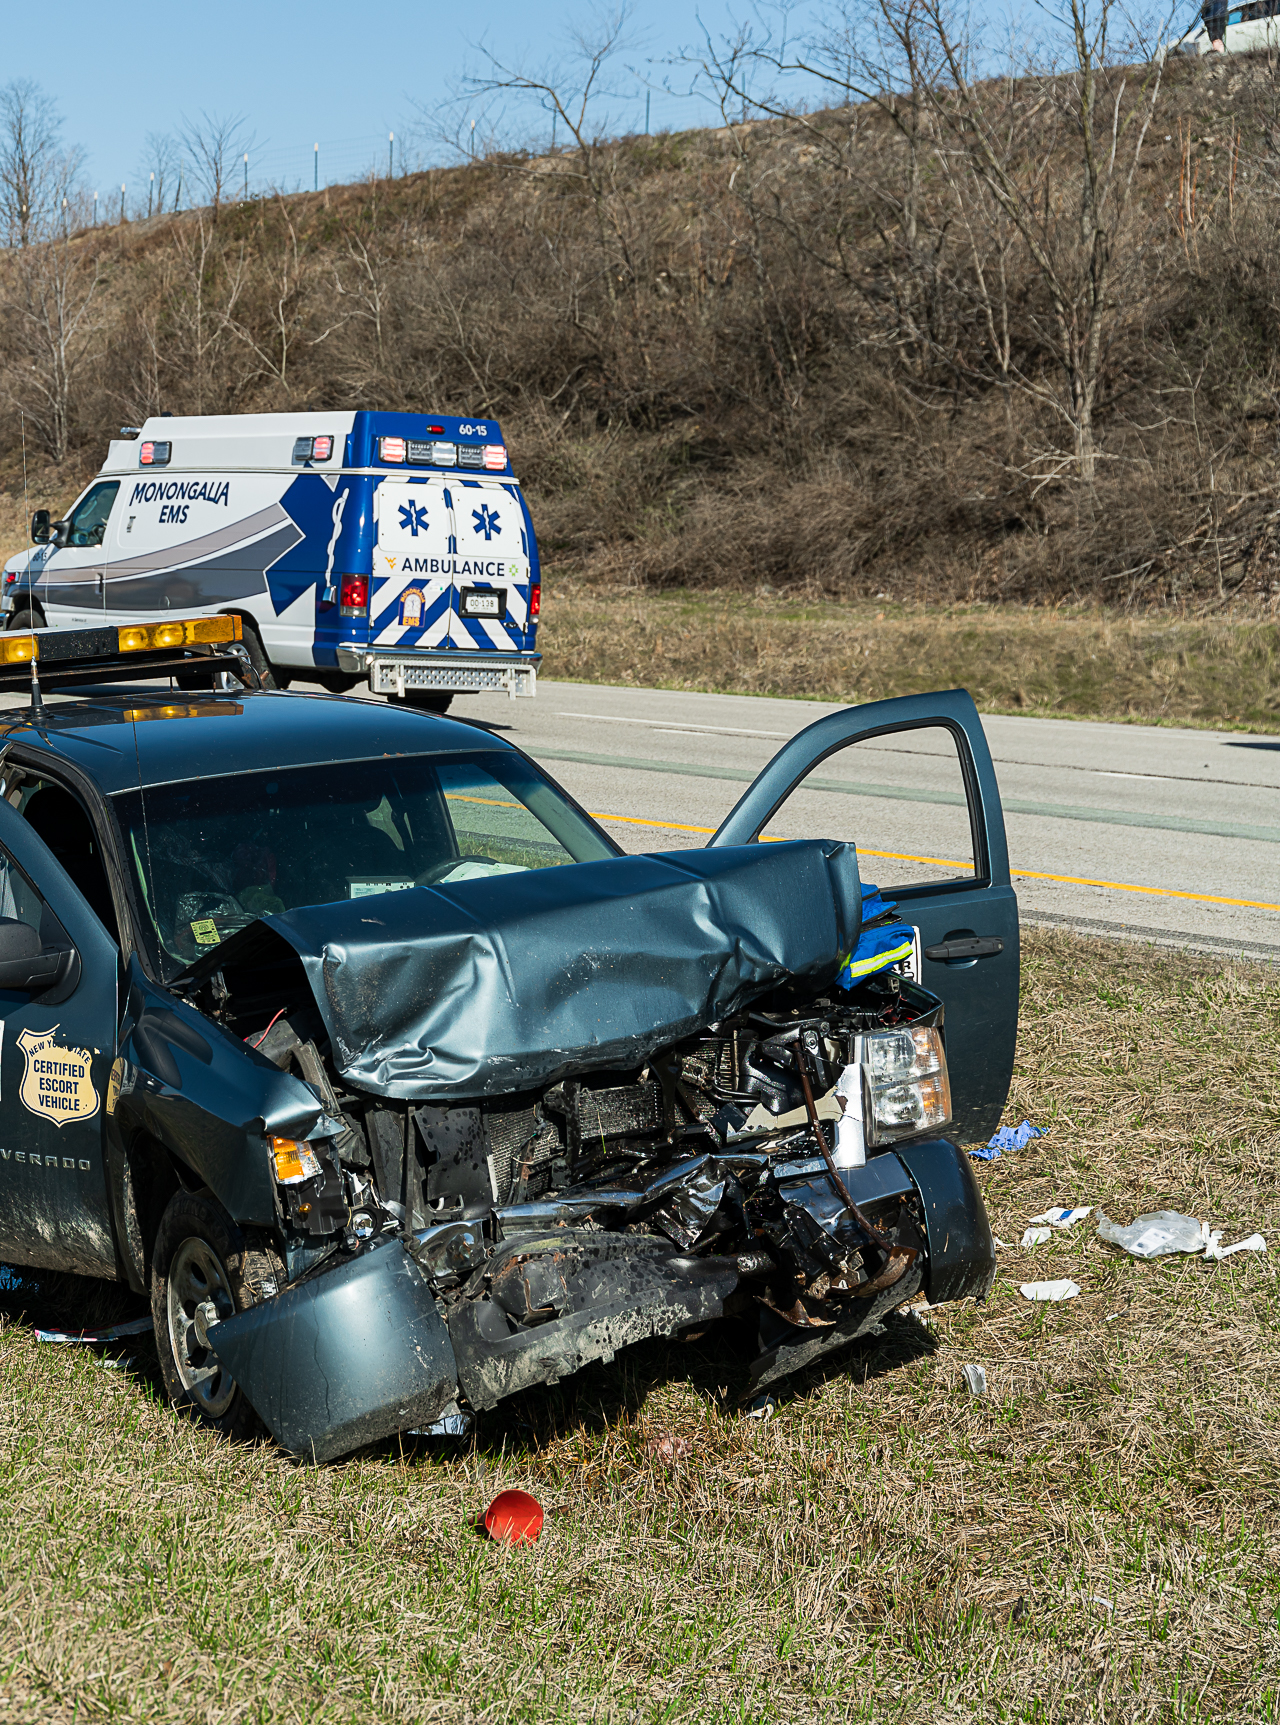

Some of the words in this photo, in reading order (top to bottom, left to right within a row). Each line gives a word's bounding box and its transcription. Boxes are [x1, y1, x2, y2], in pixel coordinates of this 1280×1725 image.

[458, 424, 488, 437] 60-15
[129, 481, 230, 506] MONONGALIA
[158, 504, 190, 524] EMS
[401, 557, 505, 577] AMBULANCE
[403, 616, 420, 627] EMS
[28, 1041, 45, 1057] NEW
[71, 1046, 91, 1065] TATE
[33, 1059, 85, 1078] CERTIFIED
[39, 1077, 80, 1094] ESCORT
[38, 1093, 80, 1111] VEHICLE
